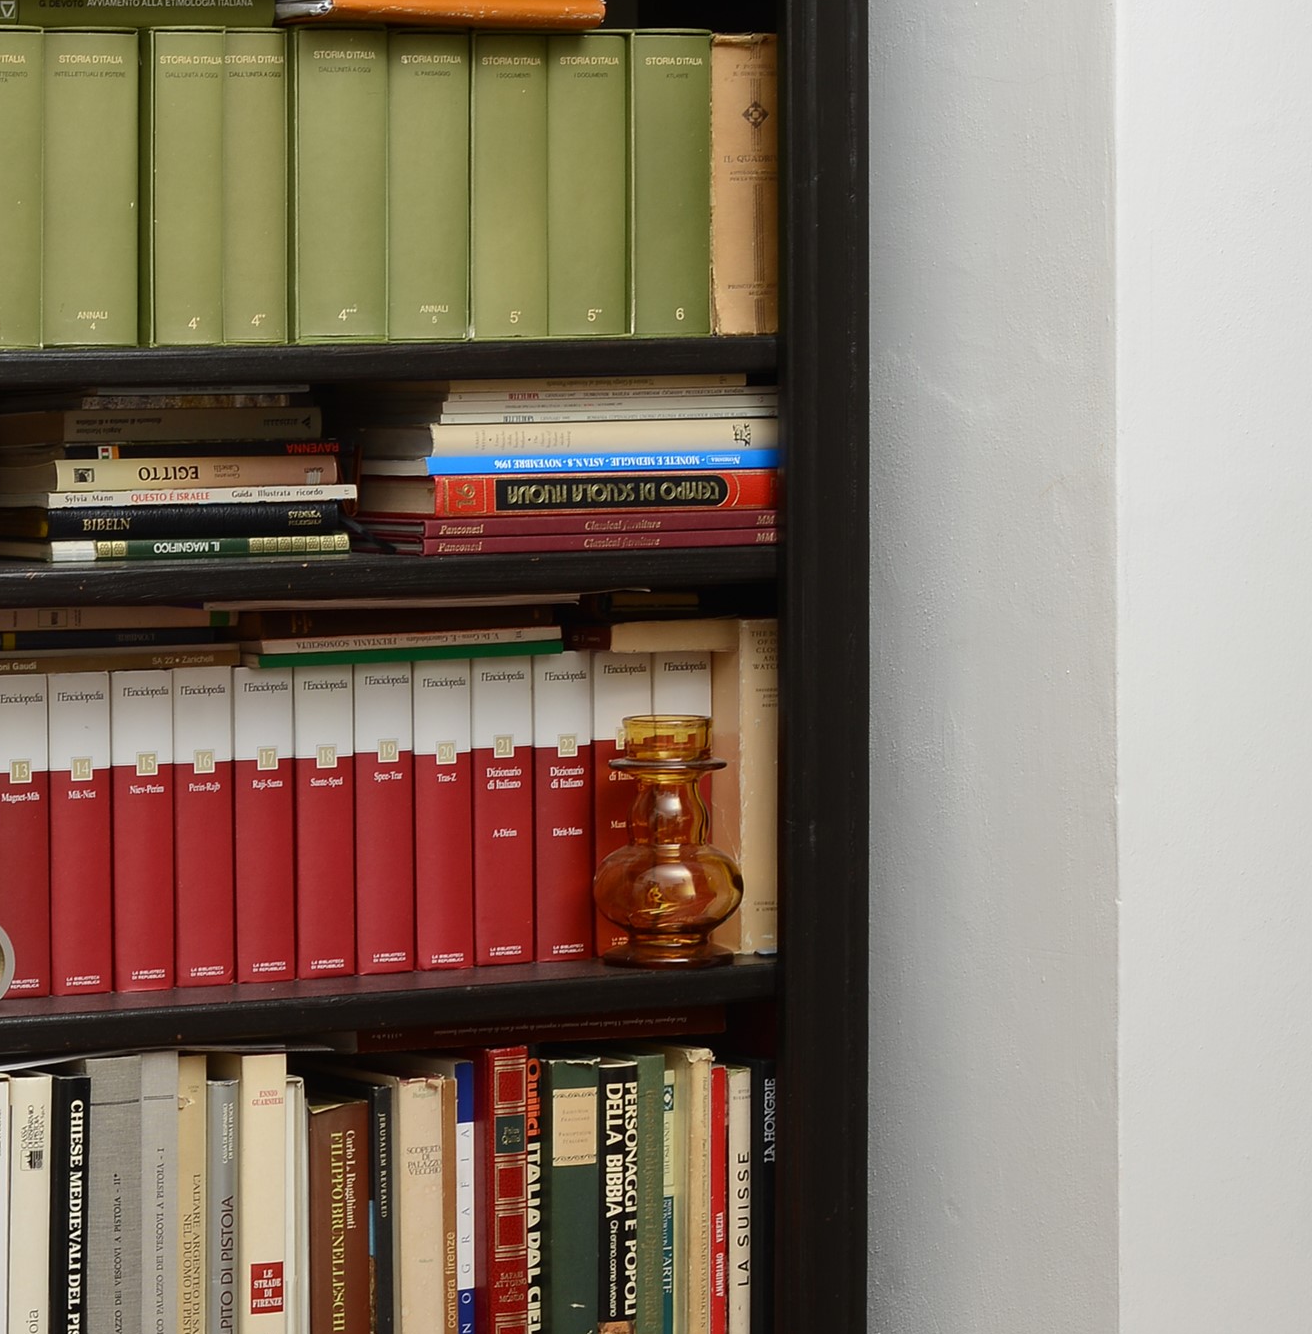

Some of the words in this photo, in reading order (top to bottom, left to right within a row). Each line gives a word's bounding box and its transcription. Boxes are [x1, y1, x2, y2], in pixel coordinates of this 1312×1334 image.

[675, 308, 685, 321] 6
[138, 466, 199, 480] EGITTO
[65, 494, 88, 503] Sylvia
[131, 493, 167, 502] QUESTO
[177, 492, 210, 501] ISRAELE
[231, 489, 253, 498] Guida
[257, 489, 291, 497] Illustrata
[297, 488, 323, 496] ricordo
[83, 518, 131, 531] BIBELN
[154, 542, 209, 553] MAGNIFICO
[210, 541, 220, 552] IL
[496, 739, 511, 753] 21
[486, 767, 522, 778] Dizionario
[486, 779, 494, 789] di
[527, 1059, 540, 1137] Quilici
[605, 1083, 623, 1145] DELLA
[69, 1100, 84, 1167] CHIESE
[625, 1082, 637, 1213] PERSONAGGI
[528, 1143, 541, 1229] ITALIA
[606, 1154, 623, 1217] BIBBIA
[737, 1152, 750, 1247] SUISSE
[67, 1171, 83, 1271] MEDIEVALI
[220, 1195, 233, 1262] PISTOIA
[625, 1219, 636, 1231] E
[528, 1233, 541, 1284] DAL
[220, 1267, 233, 1284] DI
[624, 1237, 637, 1316] POPOLI
[738, 1260, 749, 1287] LA
[67, 1274, 81, 1312] DEL
[252, 1297, 283, 1308] FIRENZE
